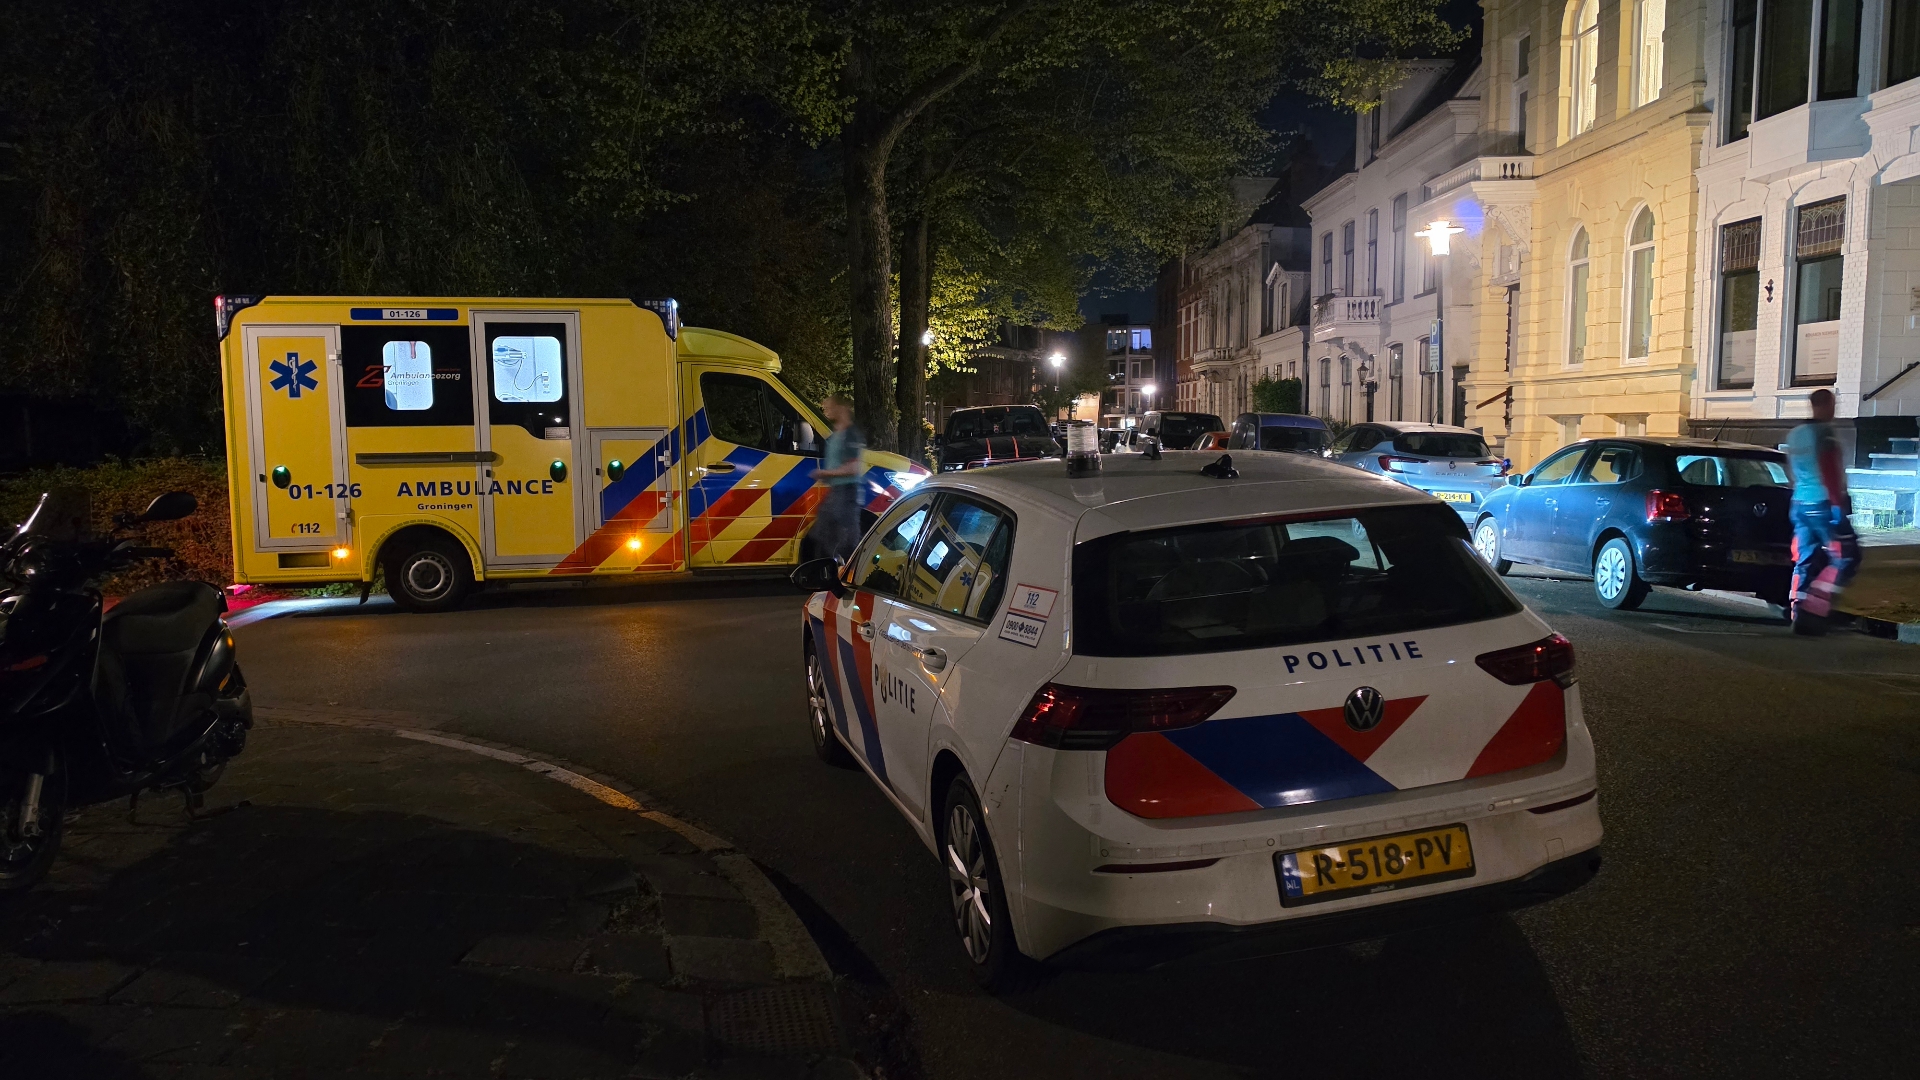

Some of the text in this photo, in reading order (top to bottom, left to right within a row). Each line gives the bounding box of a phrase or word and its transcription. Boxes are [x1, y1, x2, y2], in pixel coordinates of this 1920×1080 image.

[389, 310, 421, 318] 01-126
[1431, 323, 1438, 343] P
[390, 371, 461, 381] Ambulancezorg
[288, 483, 362, 500] 01-126
[396, 479, 554, 497] AMBULANCE
[417, 502, 473, 511] Groningen
[1282, 640, 1423, 674] POLITIE
[1312, 833, 1452, 887] R-518-PV
[1285, 879, 1300, 891] NL
